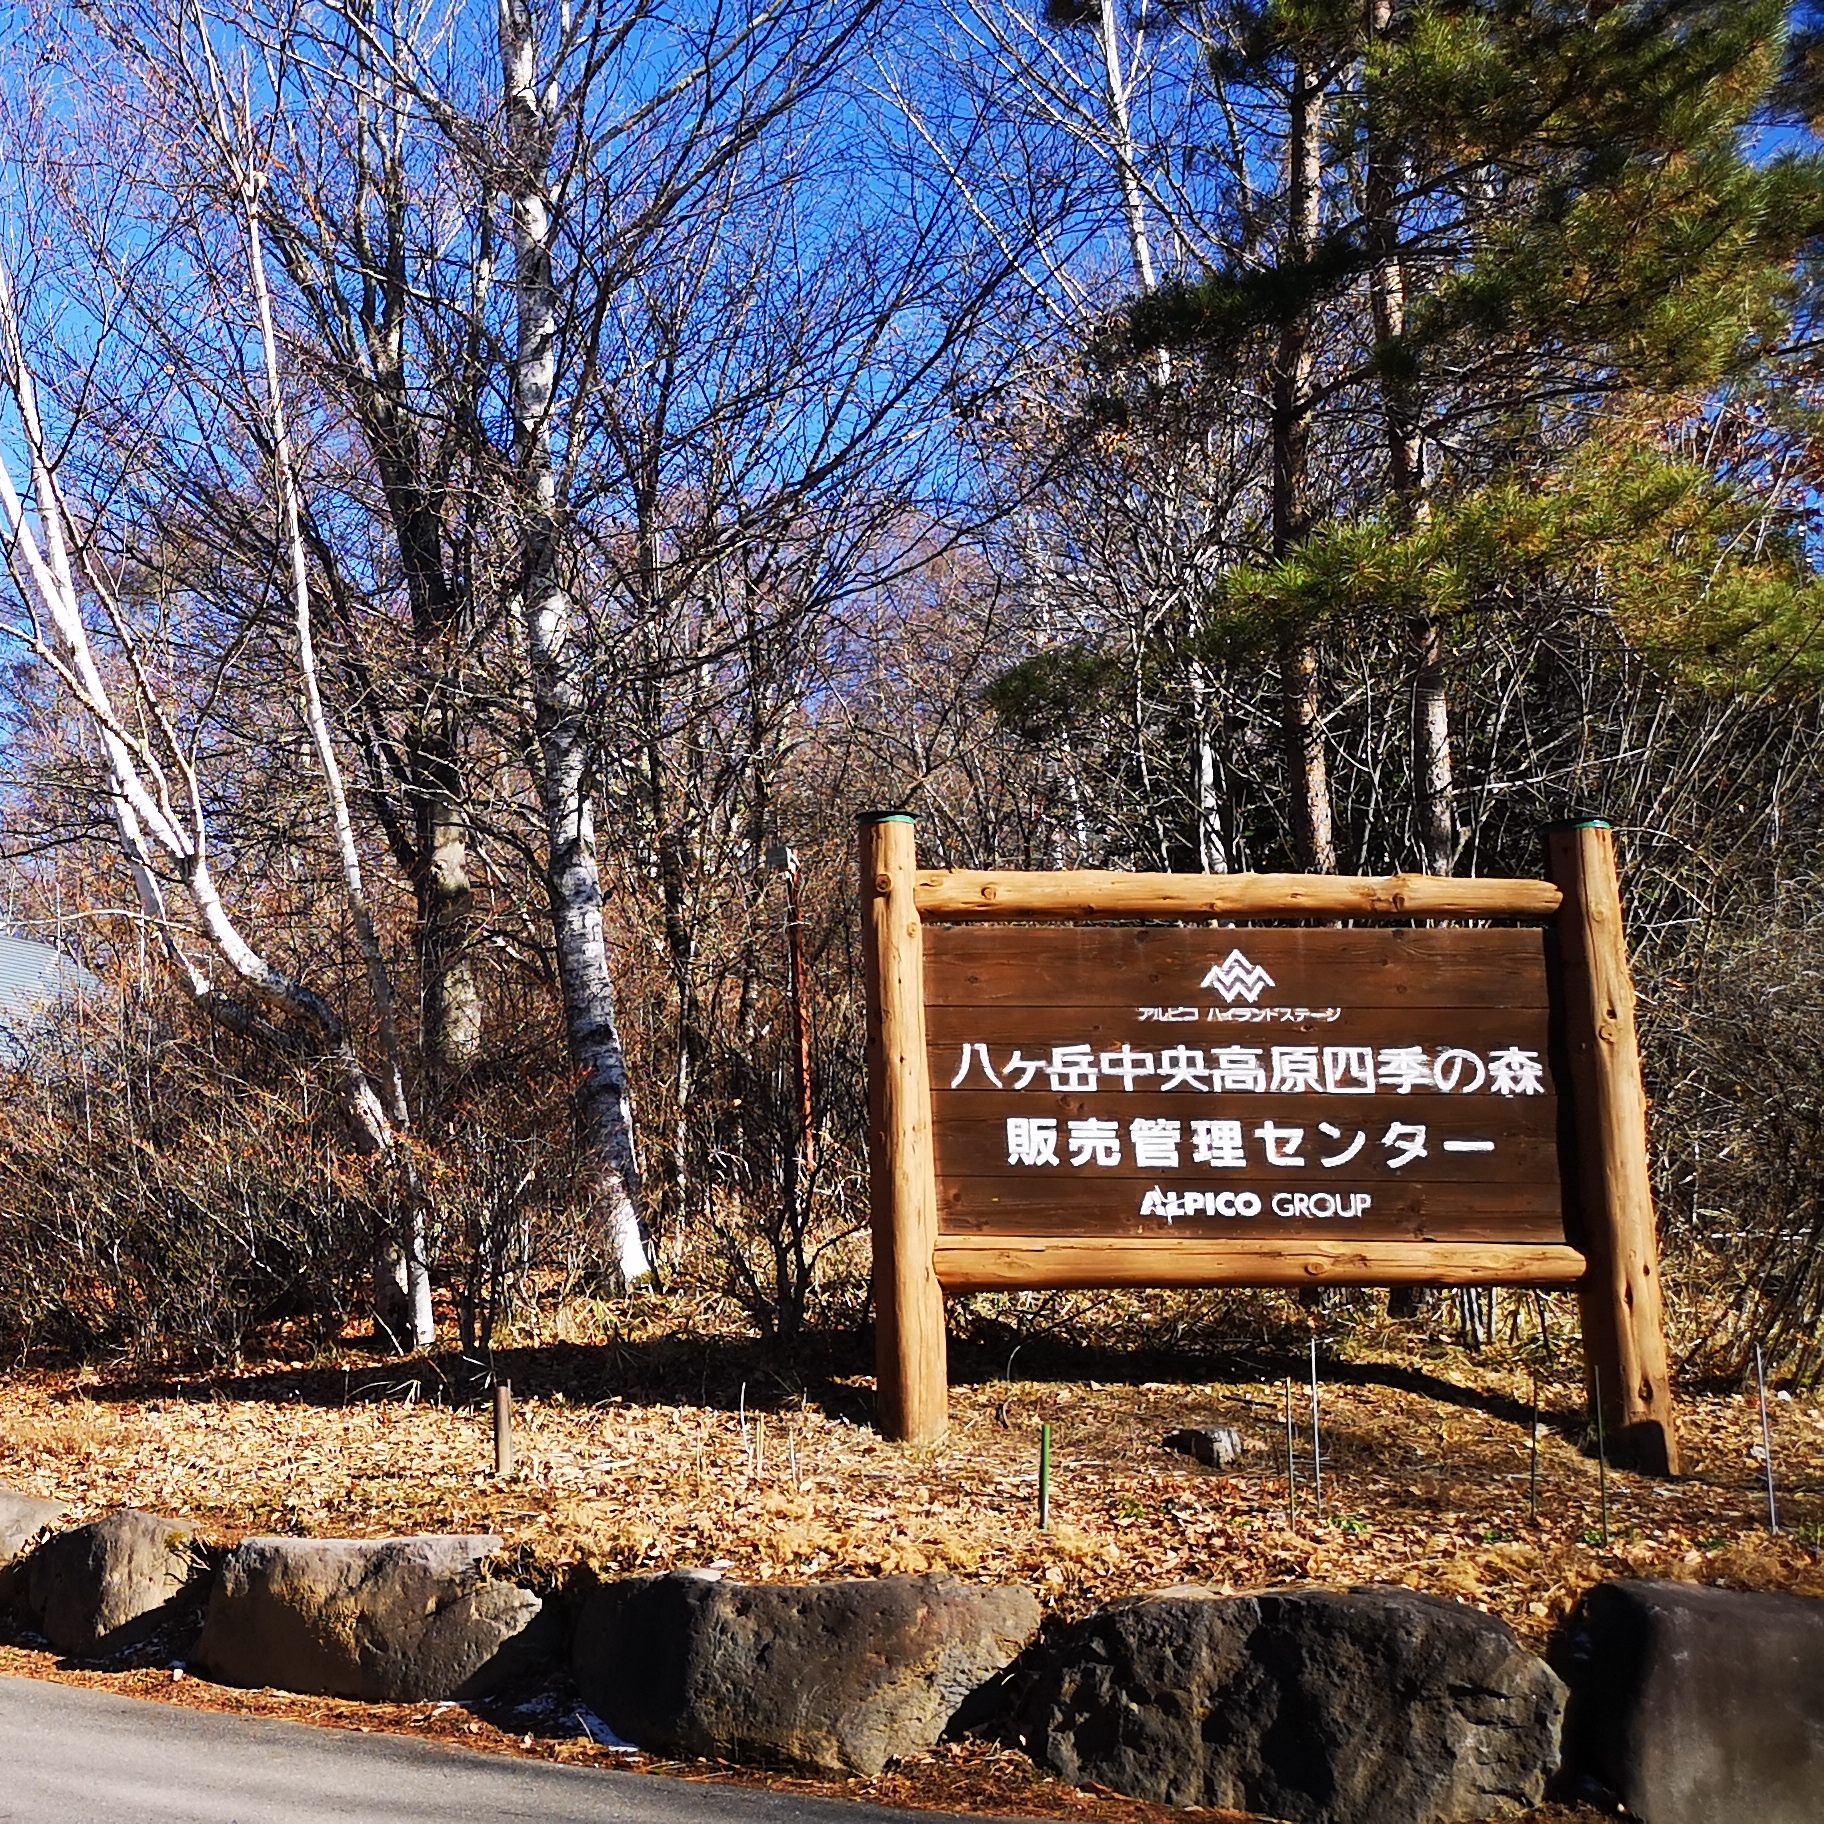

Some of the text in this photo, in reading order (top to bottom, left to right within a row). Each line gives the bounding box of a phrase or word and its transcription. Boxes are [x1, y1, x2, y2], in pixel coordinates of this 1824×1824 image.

[1207, 1007, 1342, 1022] ハイランドステージ
[1006, 1117, 1495, 1168] 販売管理センター
[1139, 1187, 1373, 1222] ALPICO GROUP
